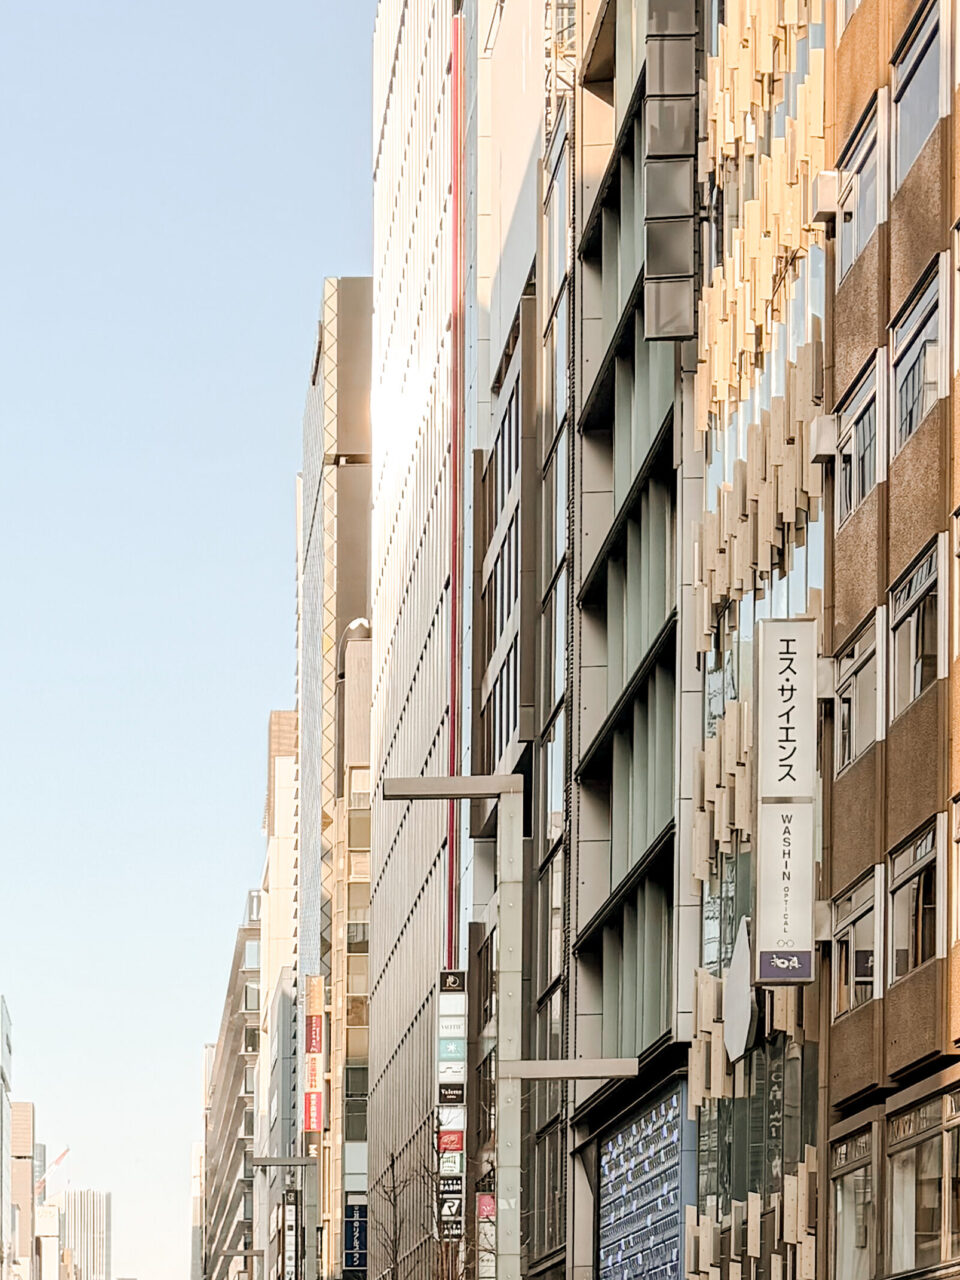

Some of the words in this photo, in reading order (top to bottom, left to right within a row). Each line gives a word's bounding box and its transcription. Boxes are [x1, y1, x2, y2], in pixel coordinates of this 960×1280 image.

[778, 638, 797, 782] エス・サイエンス
[781, 814, 793, 881] WASHIN
